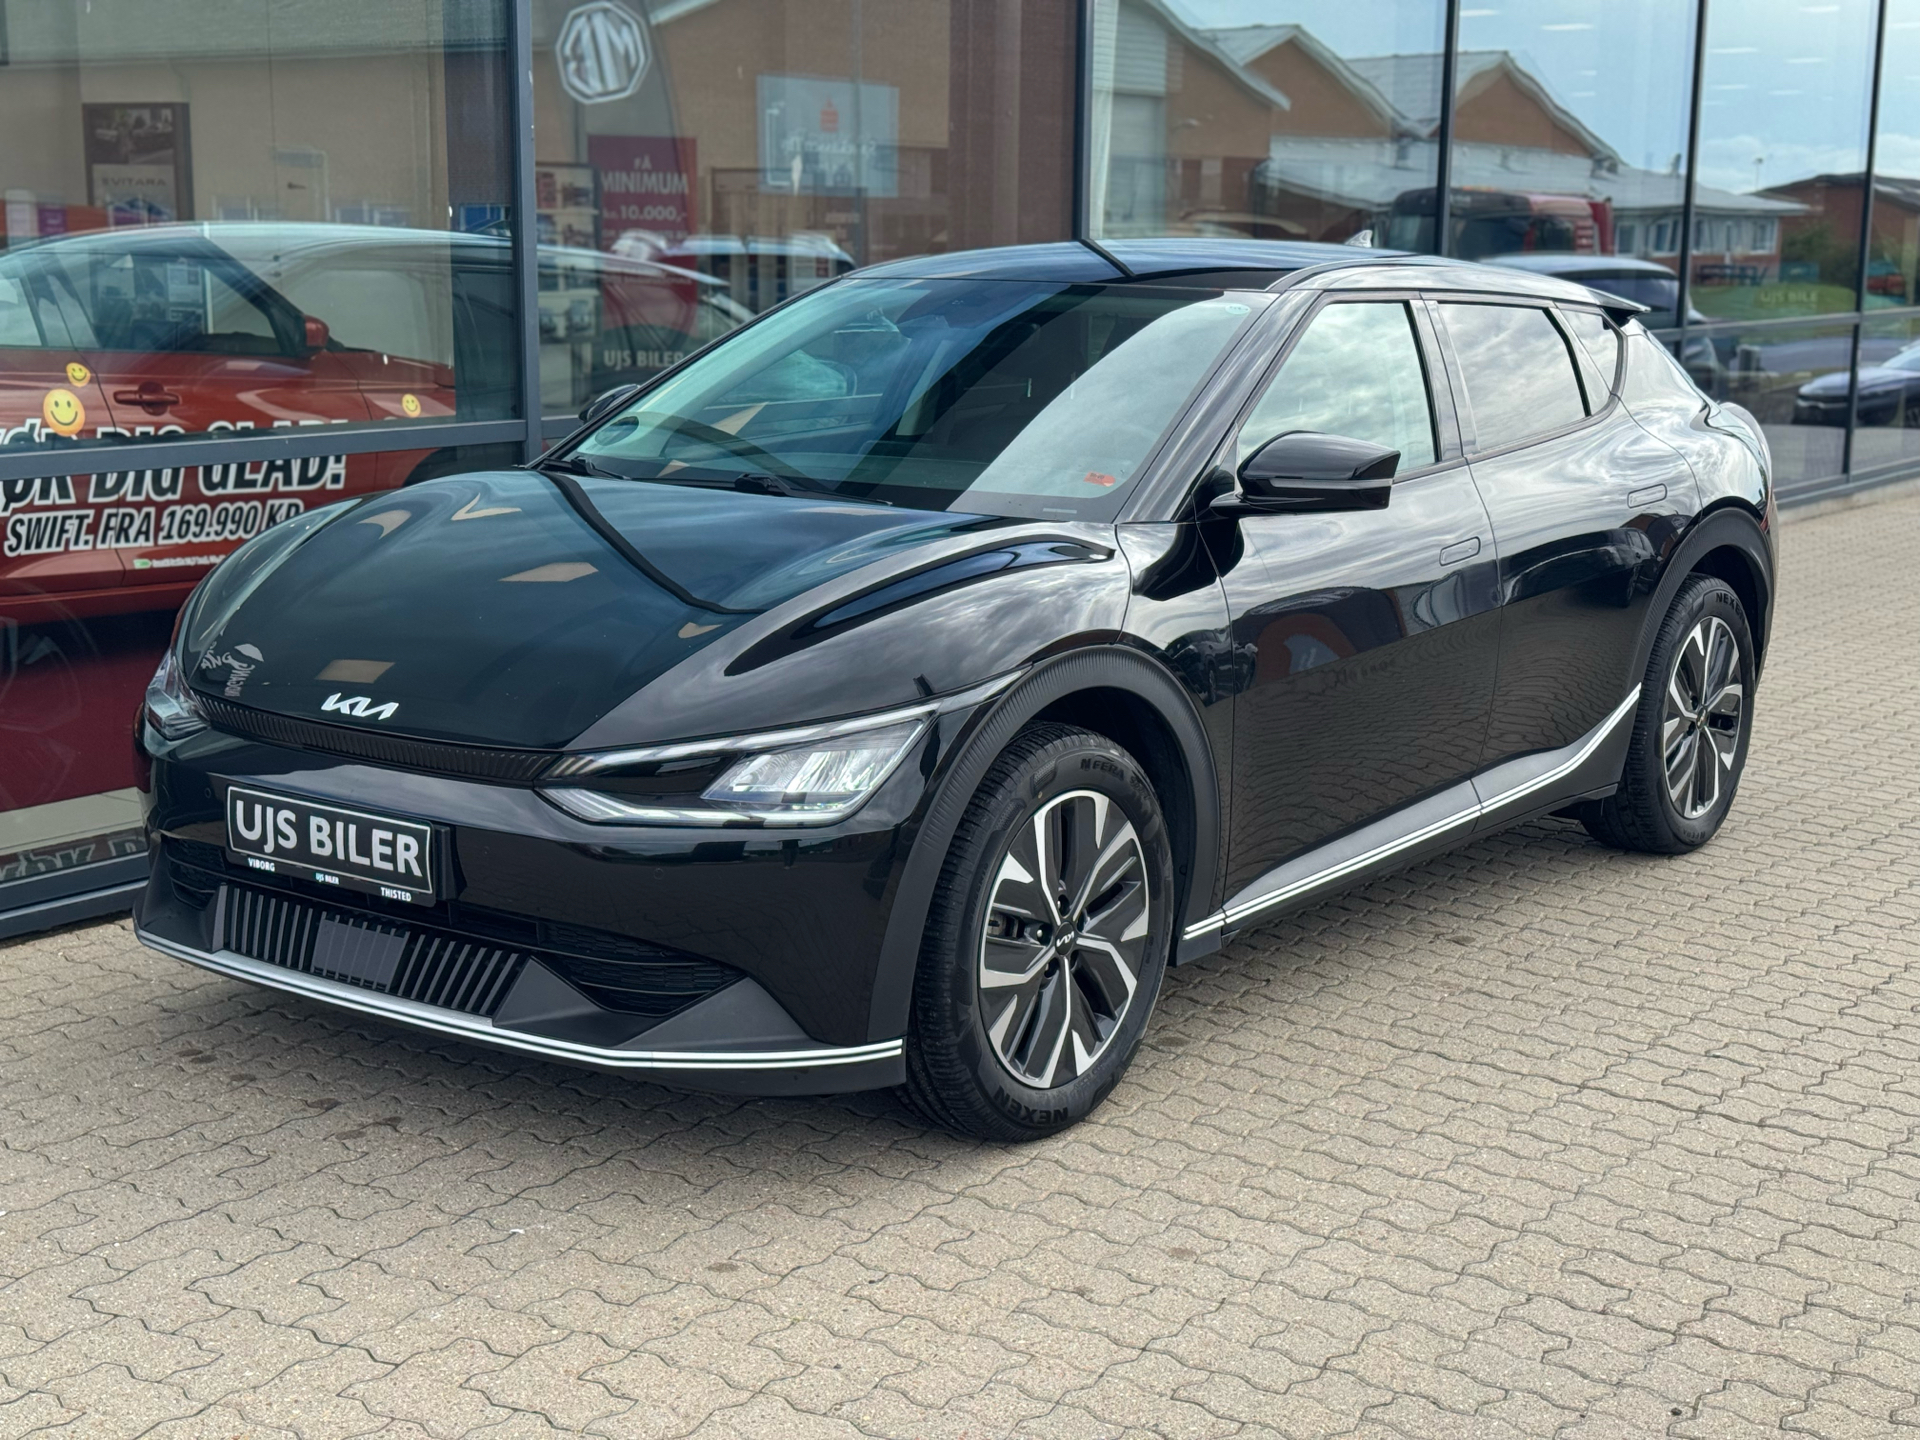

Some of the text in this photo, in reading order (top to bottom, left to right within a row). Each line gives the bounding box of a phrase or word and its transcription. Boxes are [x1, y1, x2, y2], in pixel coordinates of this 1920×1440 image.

[601, 170, 689, 195] MINIMUM
[603, 350, 632, 371] UJS
[96, 508, 155, 549] FRA
[159, 501, 262, 543] 169.990
[321, 693, 399, 720] KIA
[235, 799, 423, 878] UJS BILER
[247, 857, 276, 873] VIBORG
[380, 886, 413, 902] THISTED
[992, 1085, 1069, 1125] NEXEN
